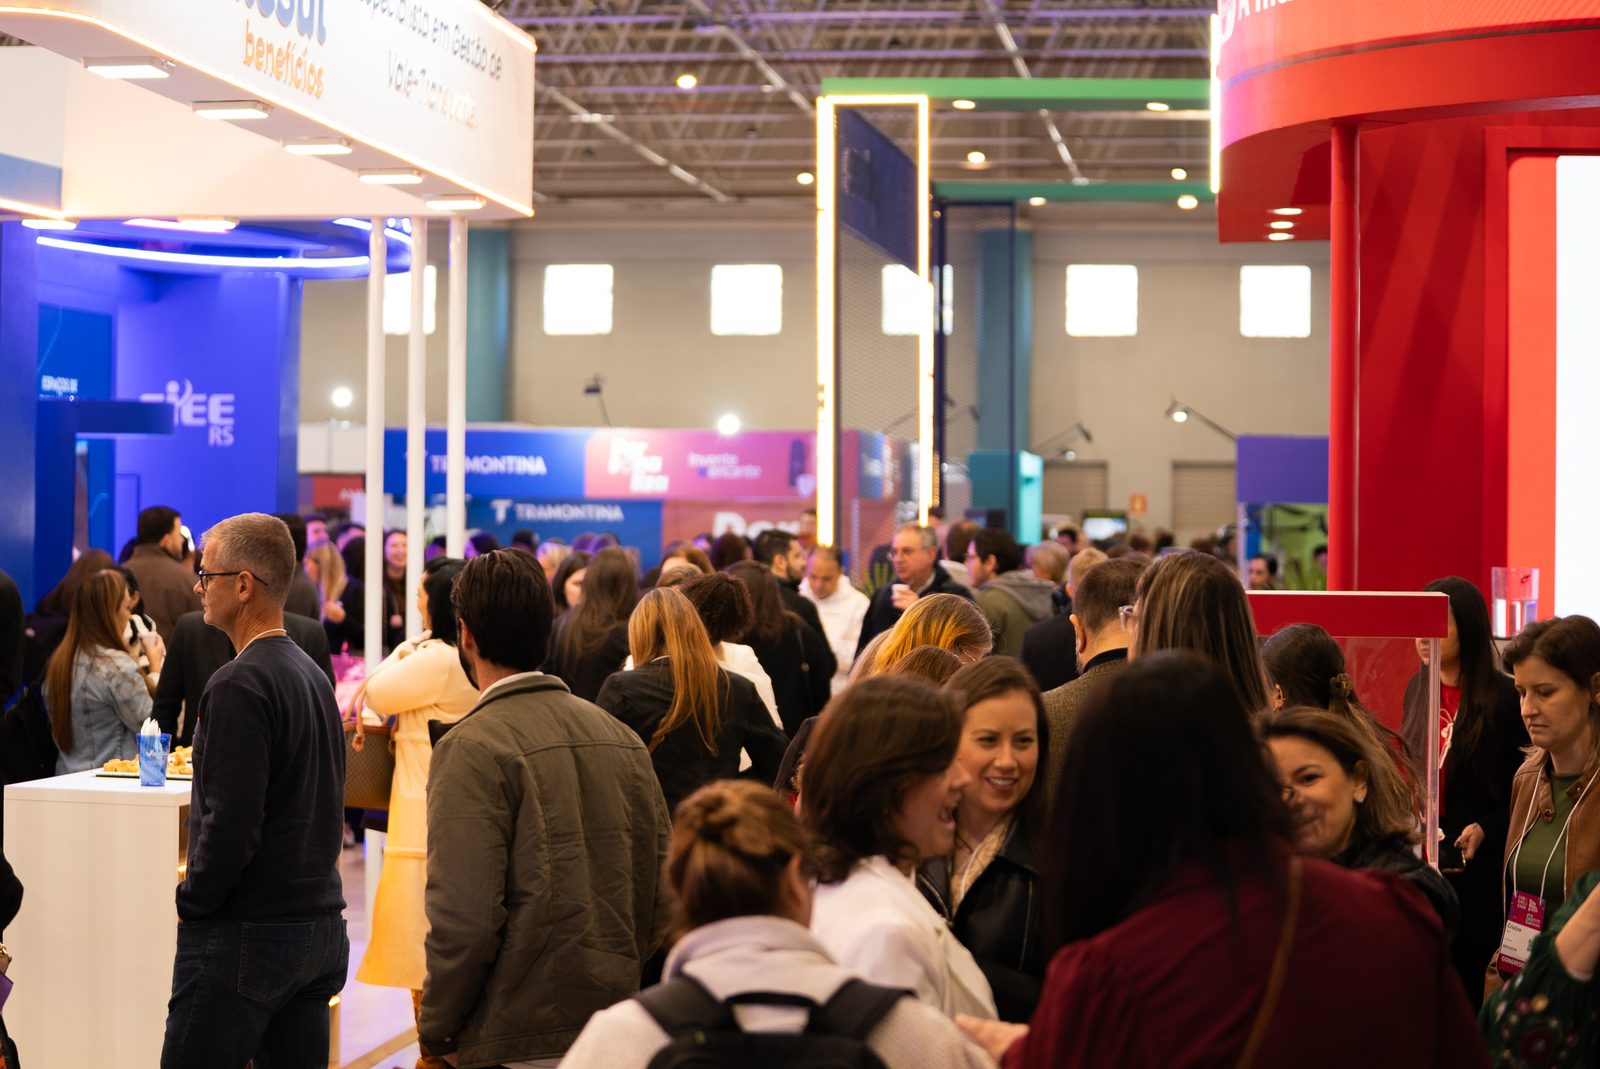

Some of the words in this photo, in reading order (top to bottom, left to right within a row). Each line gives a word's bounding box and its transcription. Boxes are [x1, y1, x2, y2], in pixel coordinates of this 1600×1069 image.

[243, 17, 325, 99] benefícios
[431, 18, 450, 49] em
[488, 47, 503, 81] de
[140, 379, 236, 426] IEE
[208, 426, 235, 447] RS
[430, 455, 547, 475] TMONTINA
[515, 503, 624, 521] TRAMONTINA
